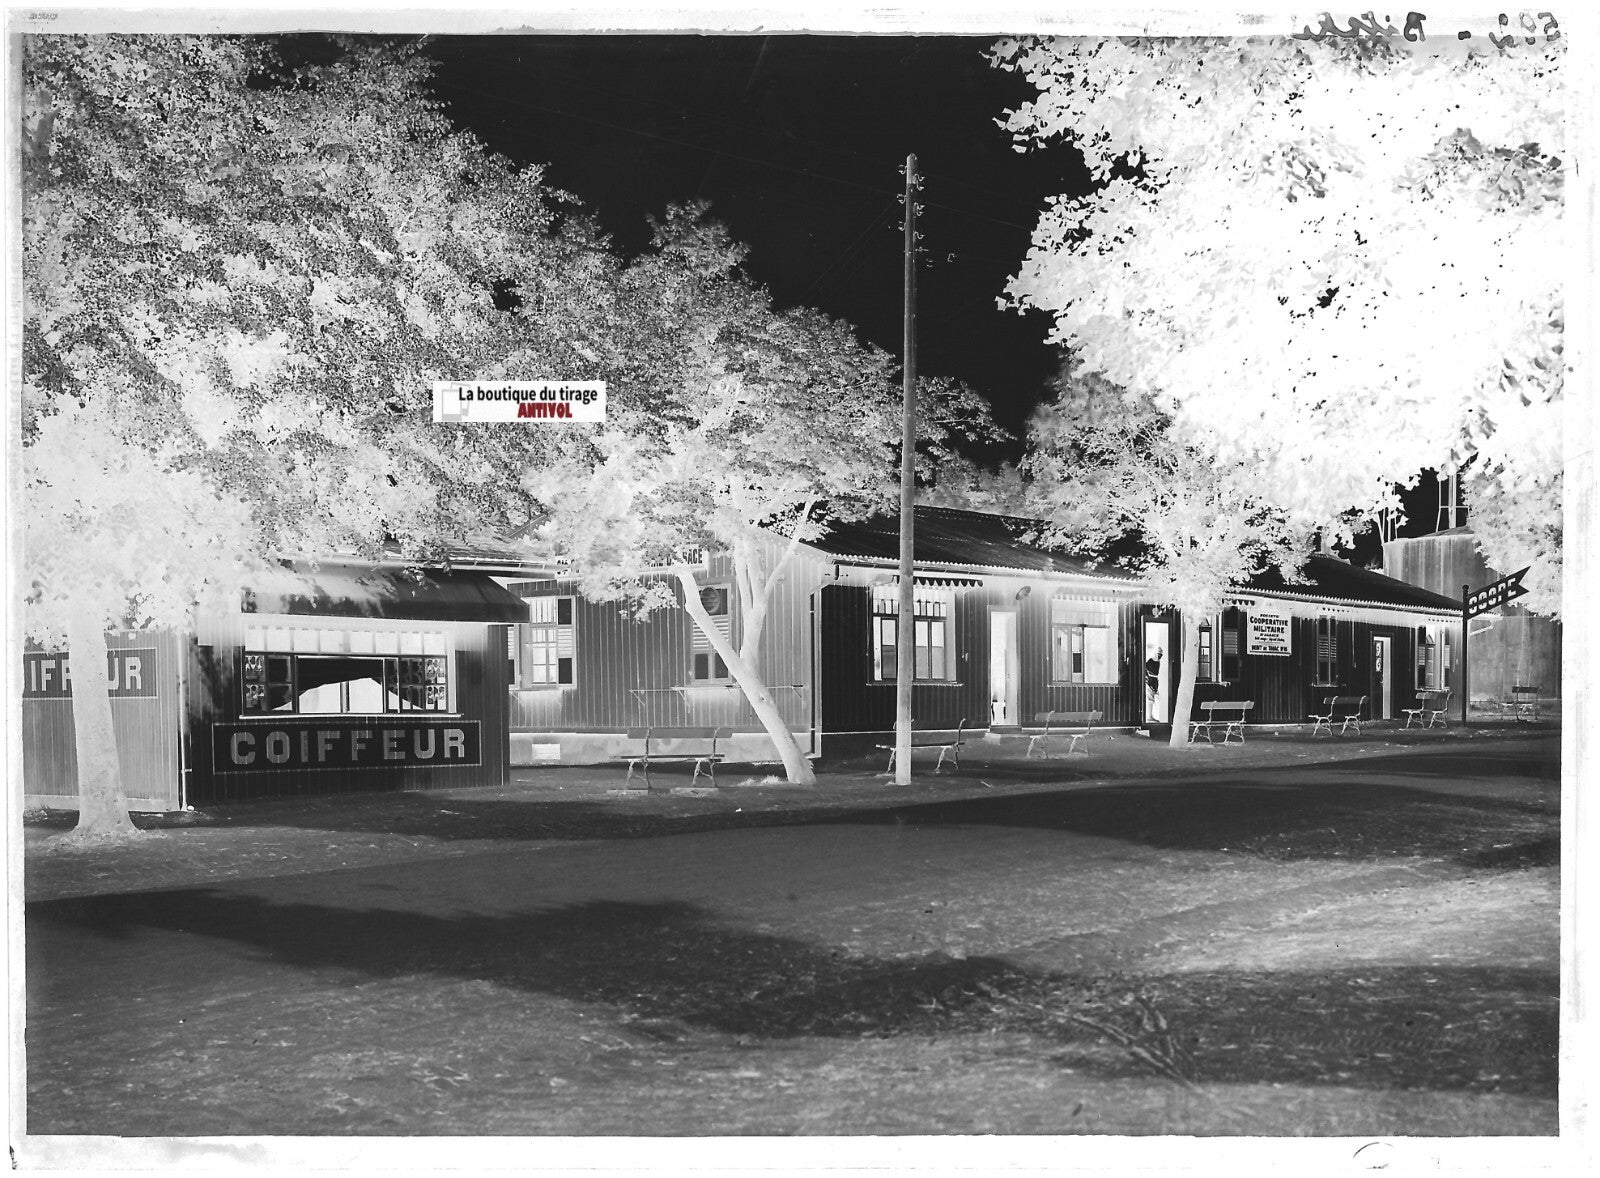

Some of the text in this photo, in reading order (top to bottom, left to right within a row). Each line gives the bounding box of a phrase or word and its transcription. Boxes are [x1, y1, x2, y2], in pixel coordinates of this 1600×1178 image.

[1468, 577, 1517, 614] COOPE
[1250, 616, 1288, 626] COOPERATIVE
[1254, 625, 1284, 633] MILITAIRE
[30, 656, 142, 691] IFFUR
[230, 728, 466, 765] COIFFEUR
